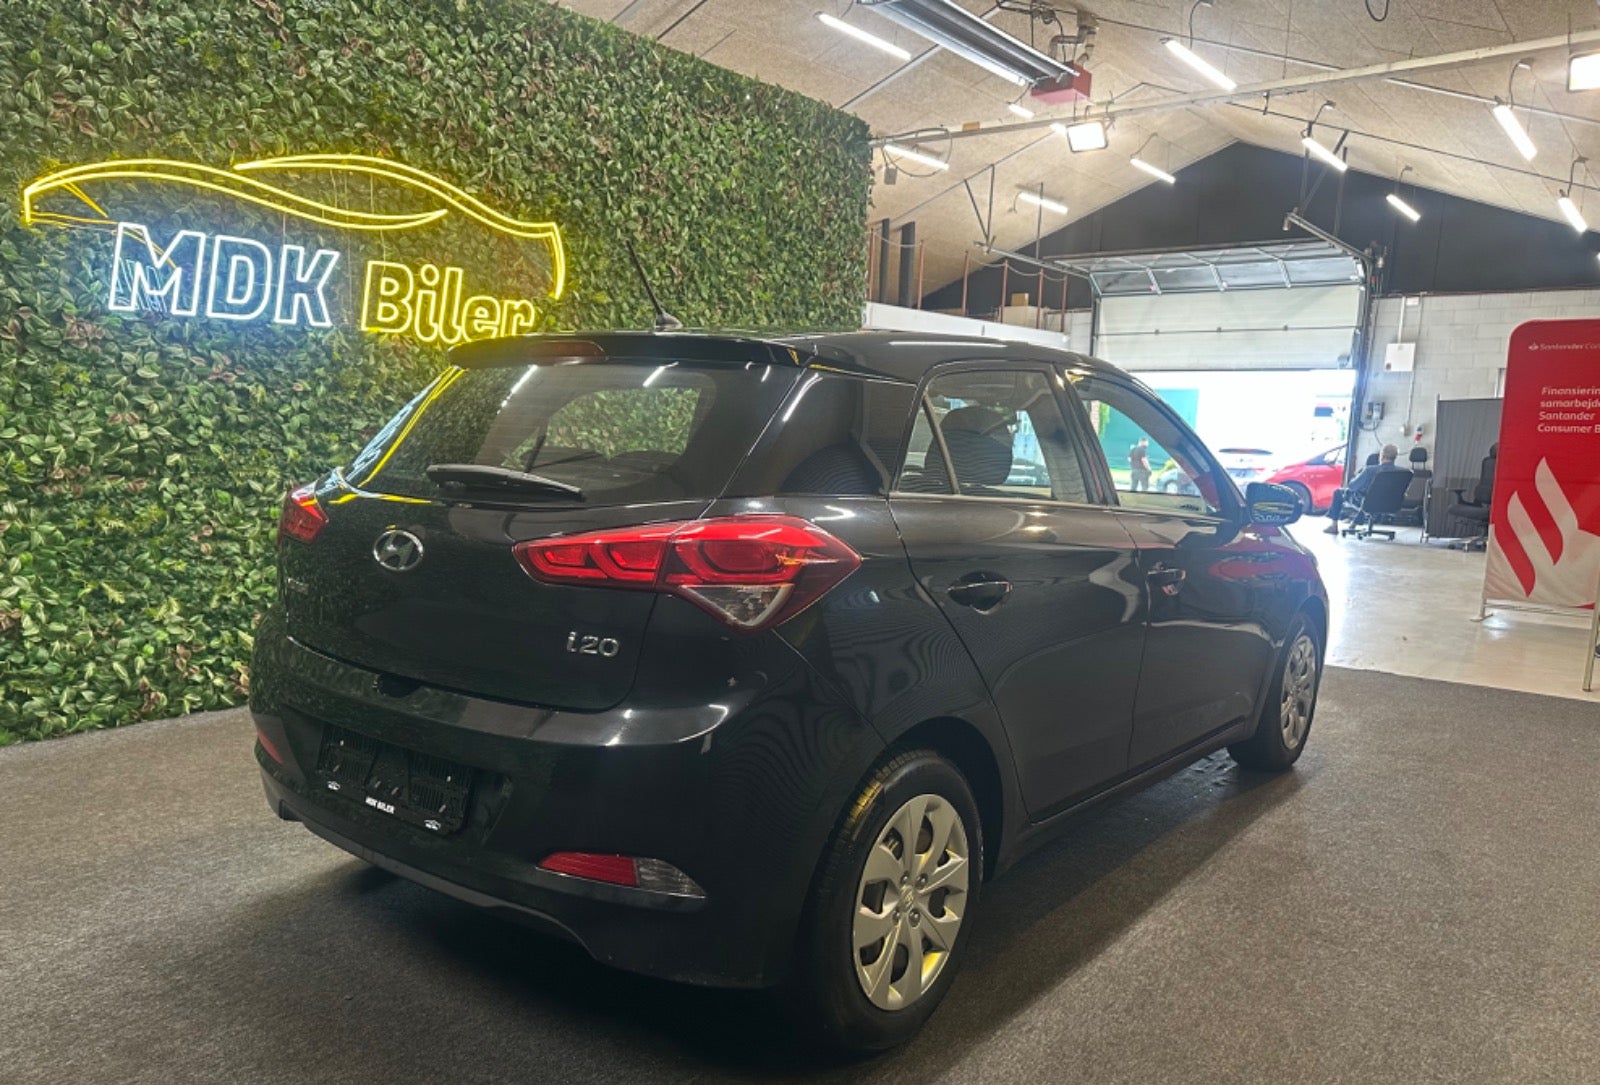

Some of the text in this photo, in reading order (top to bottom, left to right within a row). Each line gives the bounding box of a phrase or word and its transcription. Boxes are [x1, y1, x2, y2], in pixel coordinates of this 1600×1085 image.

[108, 221, 535, 343] MDK Biler
[1540, 343, 1583, 351] Santander
[1539, 411, 1596, 421] Santander
[1537, 423, 1592, 434] Consumer
[566, 631, 620, 658] i20
